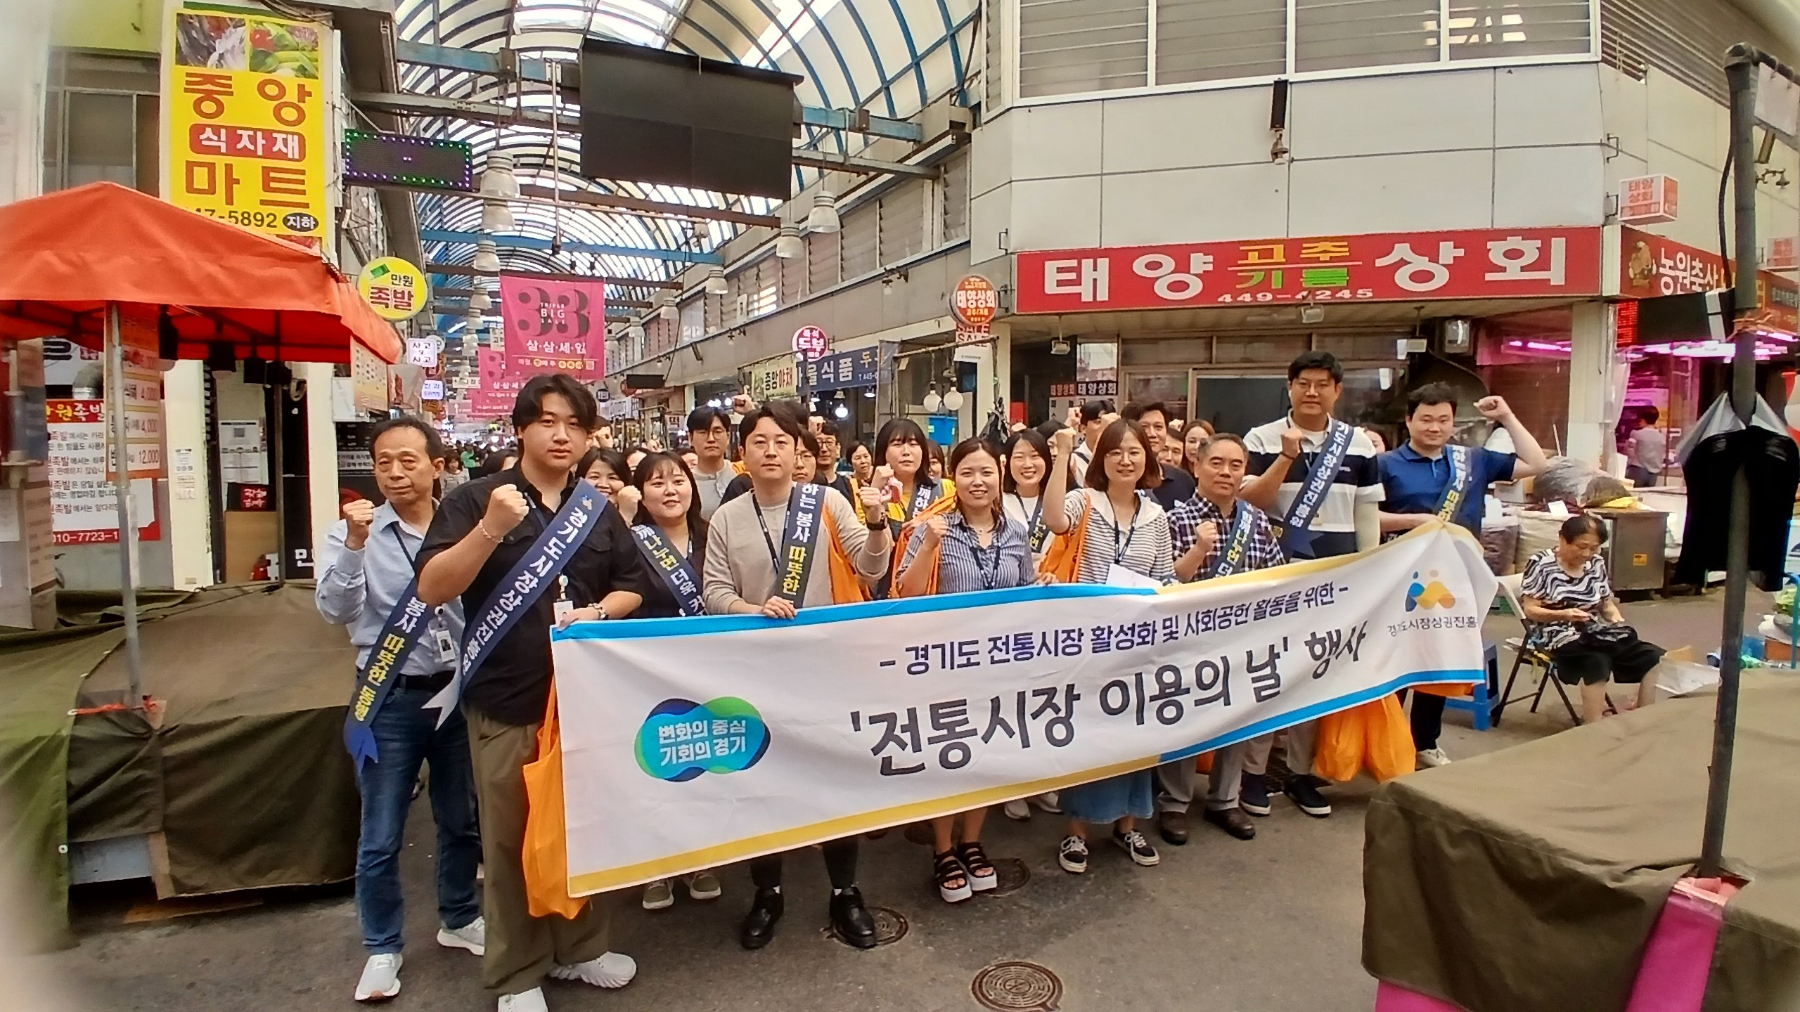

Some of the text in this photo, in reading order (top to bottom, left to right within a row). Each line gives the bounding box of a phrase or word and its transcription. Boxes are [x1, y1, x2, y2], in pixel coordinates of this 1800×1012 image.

[184, 72, 312, 126] 중앙
[199, 127, 300, 159] 식자재
[185, 161, 310, 208] 마트
[287, 216, 315, 229] 지하
[1237, 241, 1349, 264] 고추
[1375, 236, 1566, 292] 상회
[391, 274, 413, 287] 만원
[1044, 252, 1214, 302] 태양
[1236, 267, 1349, 289] 기름
[370, 286, 414, 311] 족발
[957, 290, 995, 308] 태양상회
[1218, 288, 1373, 303] 449-4245
[541, 309, 565, 318] BIG
[798, 337, 824, 352] 두부
[860, 349, 878, 369] 두
[1078, 382, 1117, 395] 태양상회
[792, 511, 813, 543] 봉사
[783, 545, 807, 596] 따뜻한
[1214, 562, 1233, 579] 더
[461, 507, 588, 676] 경기도시장상권진흥원
[394, 596, 427, 633] 봉사
[905, 580, 1335, 675] 경기도 전통시장 활성화 및 사회공헌 활동을 위한
[368, 633, 405, 687] 따뜻한
[1100, 655, 1231, 727] 이용의
[1304, 620, 1368, 680] 행사
[658, 719, 746, 744] 변화의 중심
[660, 736, 746, 766] 기회의 경기
